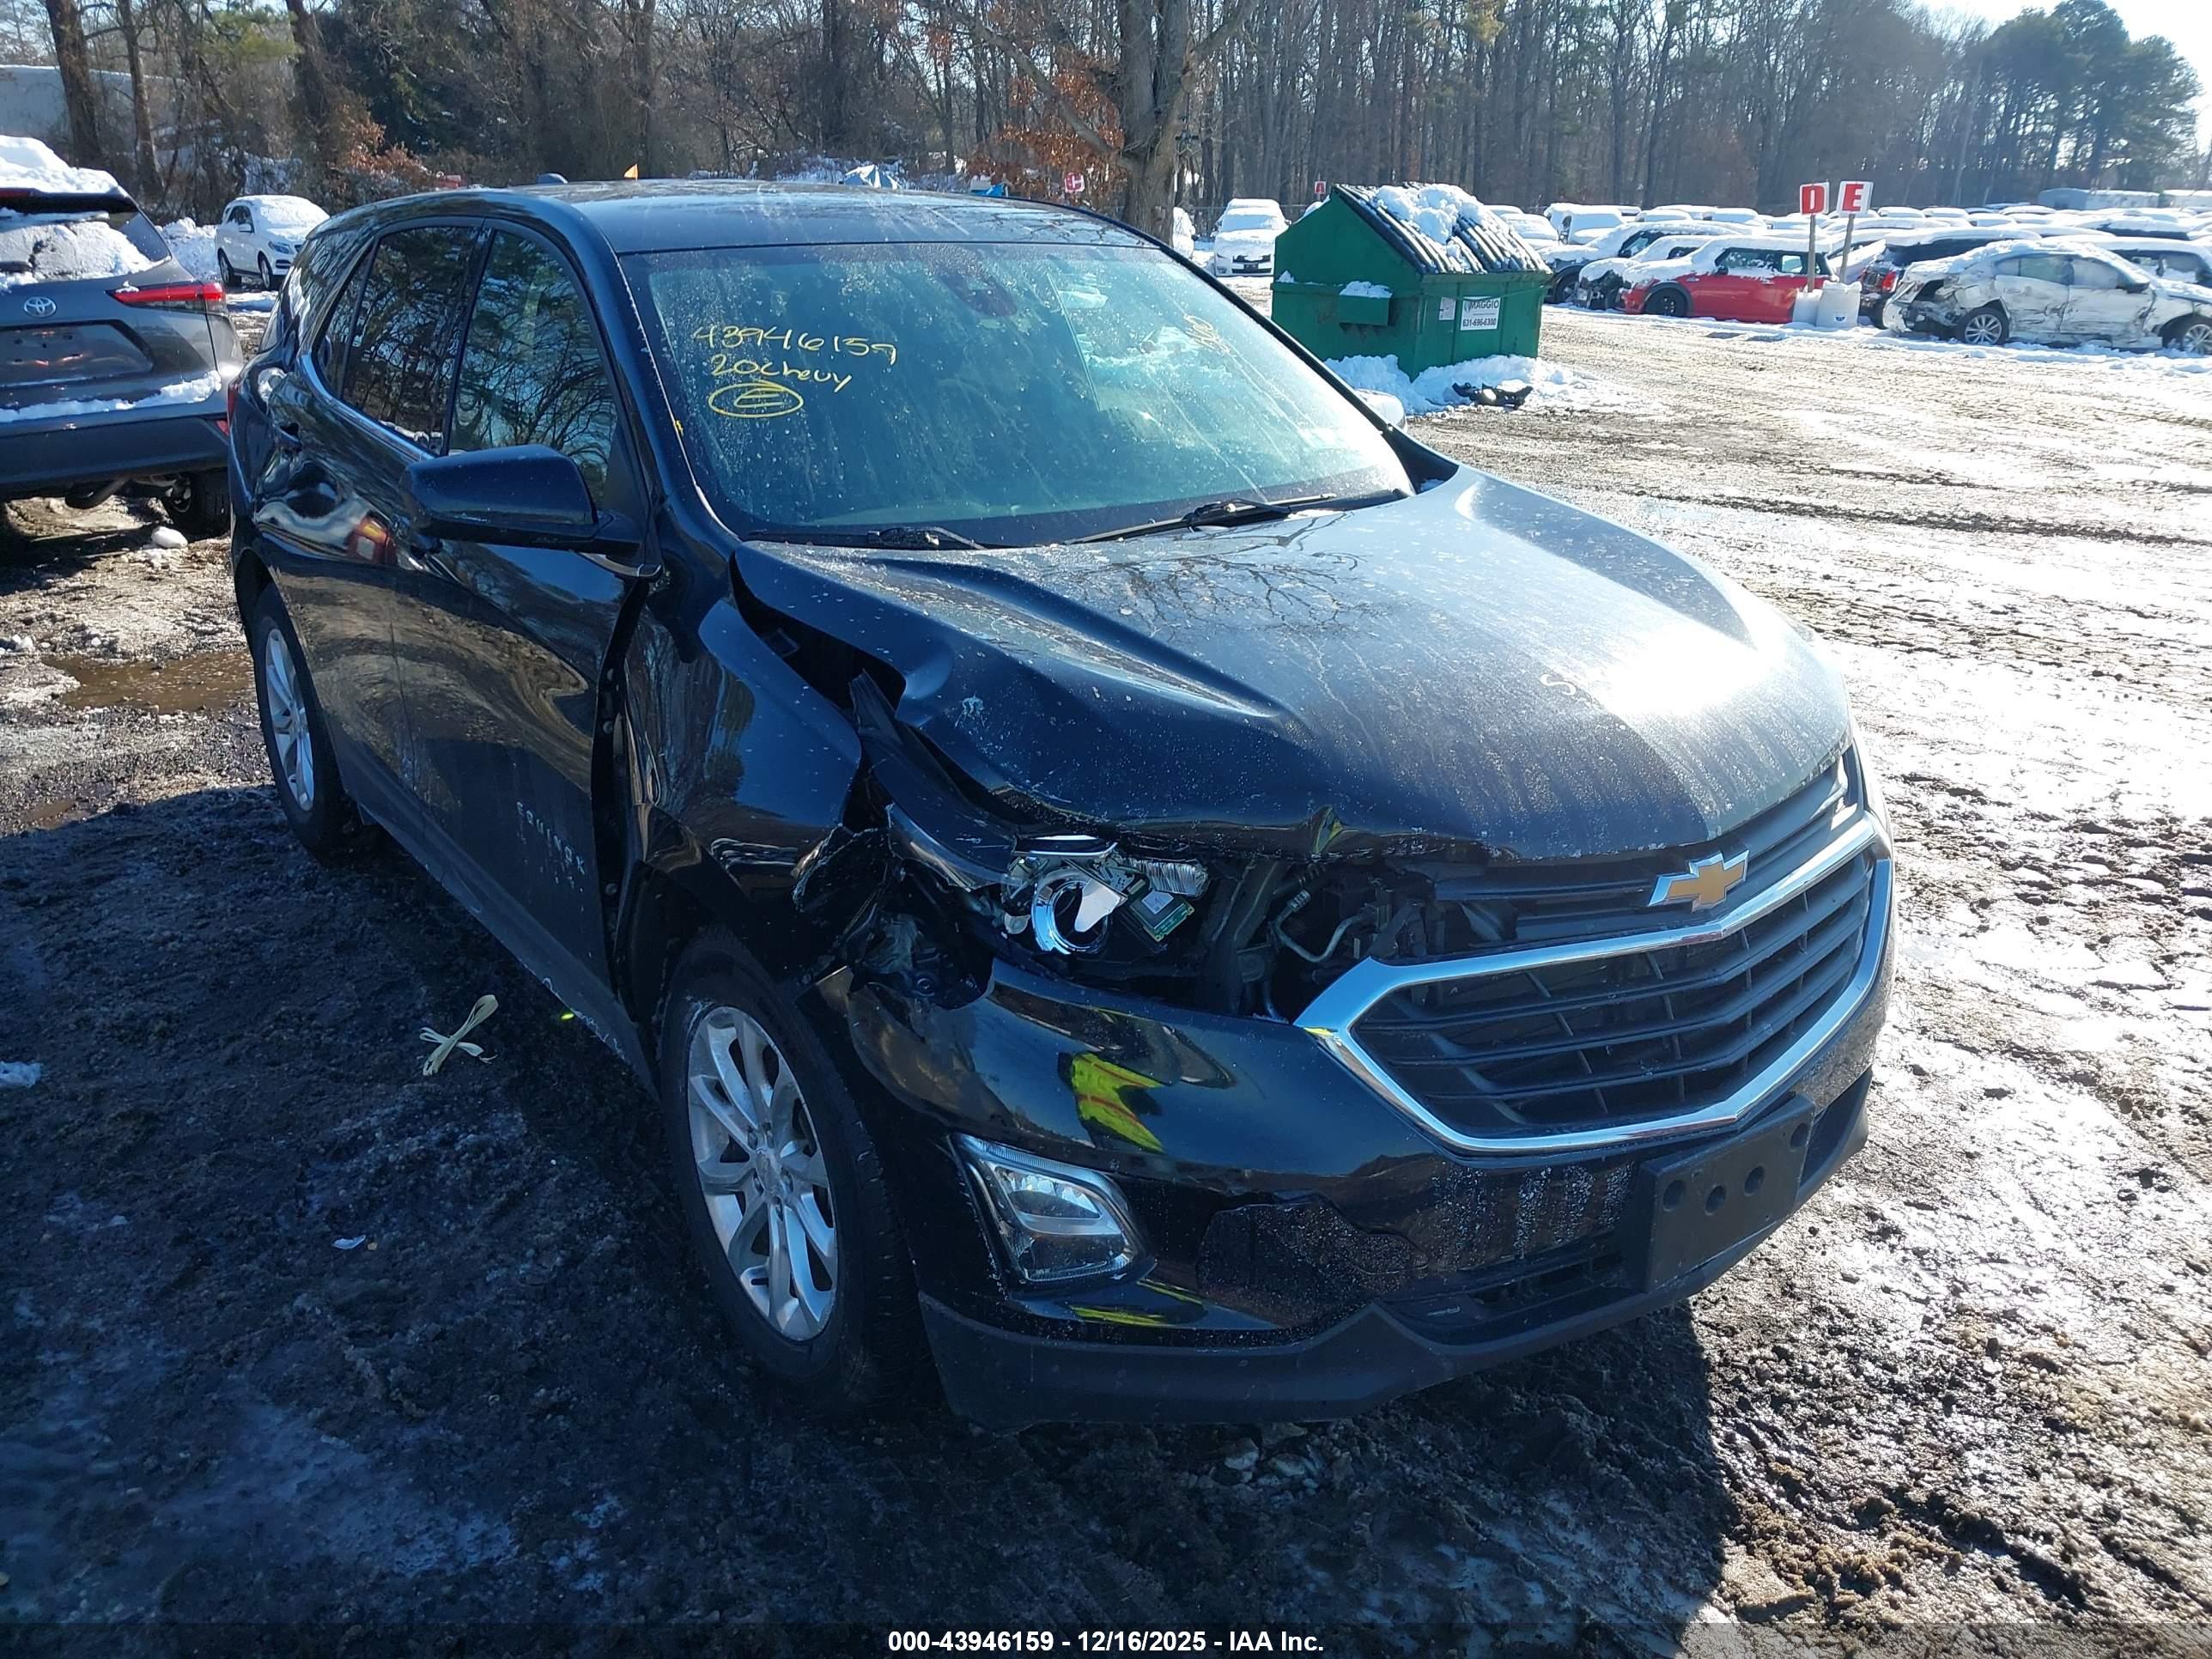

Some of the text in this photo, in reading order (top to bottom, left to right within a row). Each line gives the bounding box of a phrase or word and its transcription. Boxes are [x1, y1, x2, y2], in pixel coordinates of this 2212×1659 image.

[1316, 182, 1326, 193] A
[1802, 185, 1825, 214] D
[1842, 183, 1864, 211] E
[1469, 300, 1499, 310] MAGGIO
[693, 325, 897, 366] 43946159
[516, 801, 586, 875] EQUINOX
